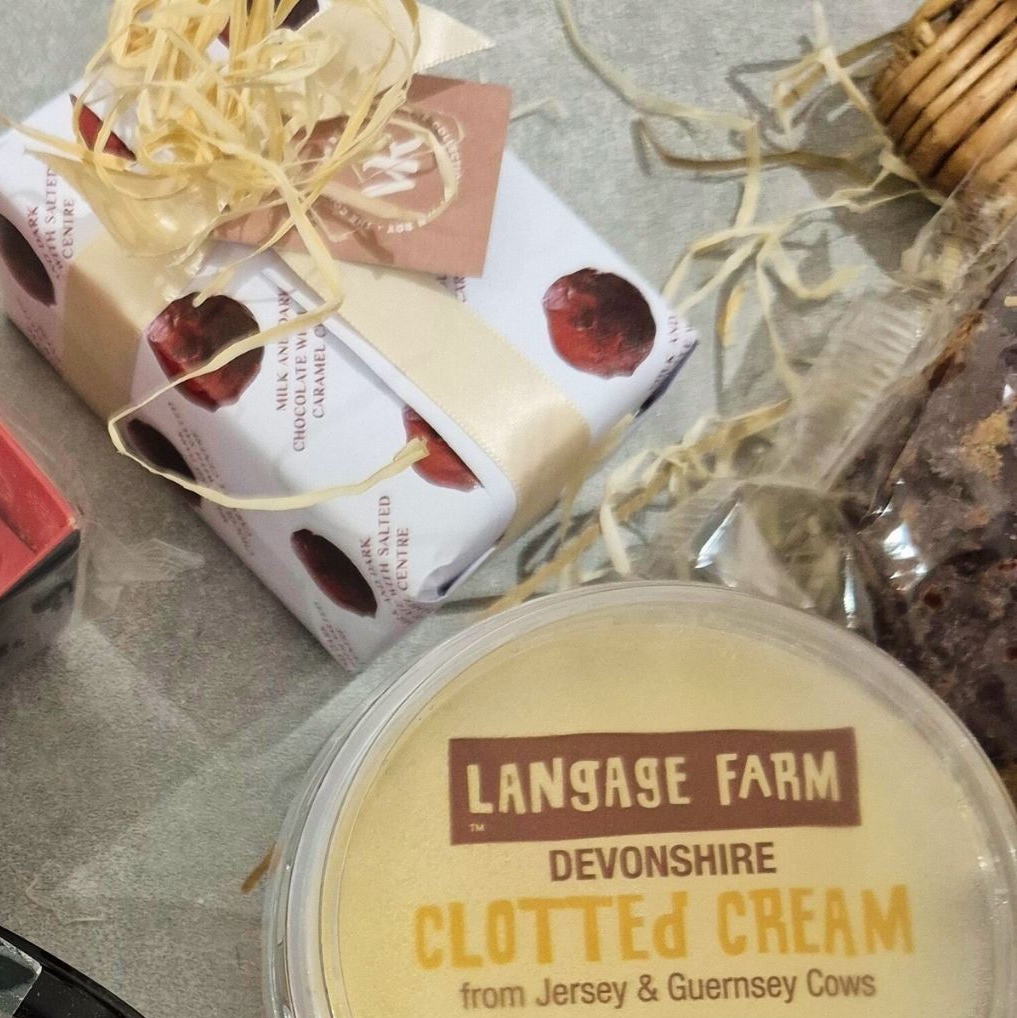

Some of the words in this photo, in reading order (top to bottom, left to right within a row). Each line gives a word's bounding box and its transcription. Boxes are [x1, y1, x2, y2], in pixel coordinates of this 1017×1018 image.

[276, 372, 289, 411] MILK
[293, 355, 307, 452] CHOCOLATE
[312, 344, 326, 418] CARAMEL
[376, 495, 391, 557] SALTED
[396, 526, 409, 591] CENTRE
[715, 750, 842, 806] FARM
[548, 841, 778, 882] DEVONSHIRE
[717, 884, 915, 957] CREAM
[459, 981, 526, 1010] from
[535, 976, 628, 1009] Jersey
[638, 973, 659, 1003] &
[667, 970, 798, 1004] Guernsey
[806, 967, 877, 998] Cows
